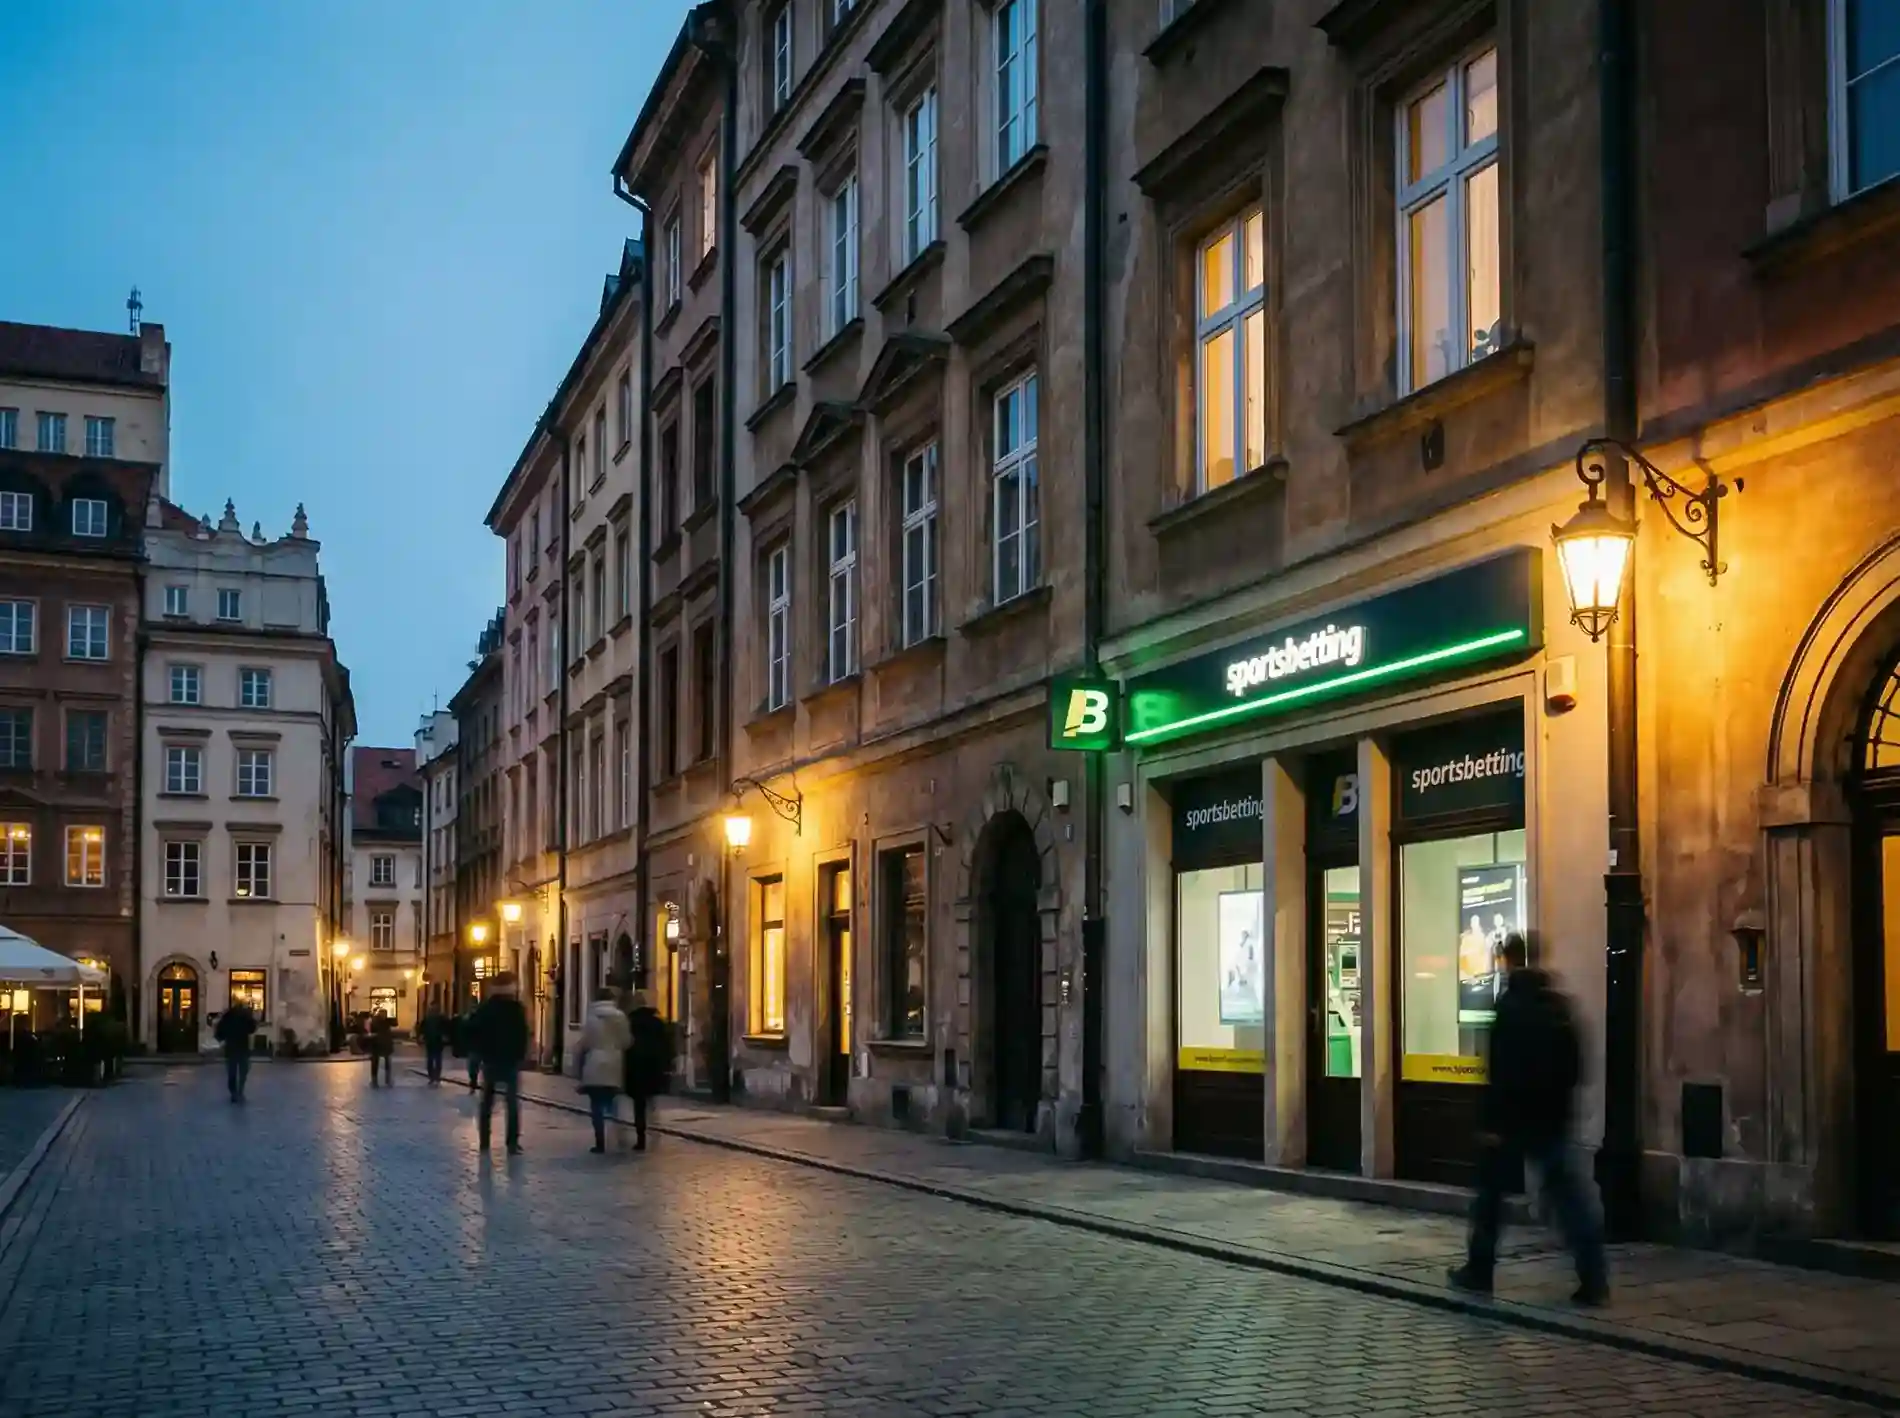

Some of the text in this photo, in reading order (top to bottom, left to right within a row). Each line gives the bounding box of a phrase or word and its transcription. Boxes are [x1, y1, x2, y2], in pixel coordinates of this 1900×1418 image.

[1226, 624, 1362, 697] sportsbetting
[1063, 689, 1109, 737] B
[1412, 748, 1525, 793] sportsbetting
